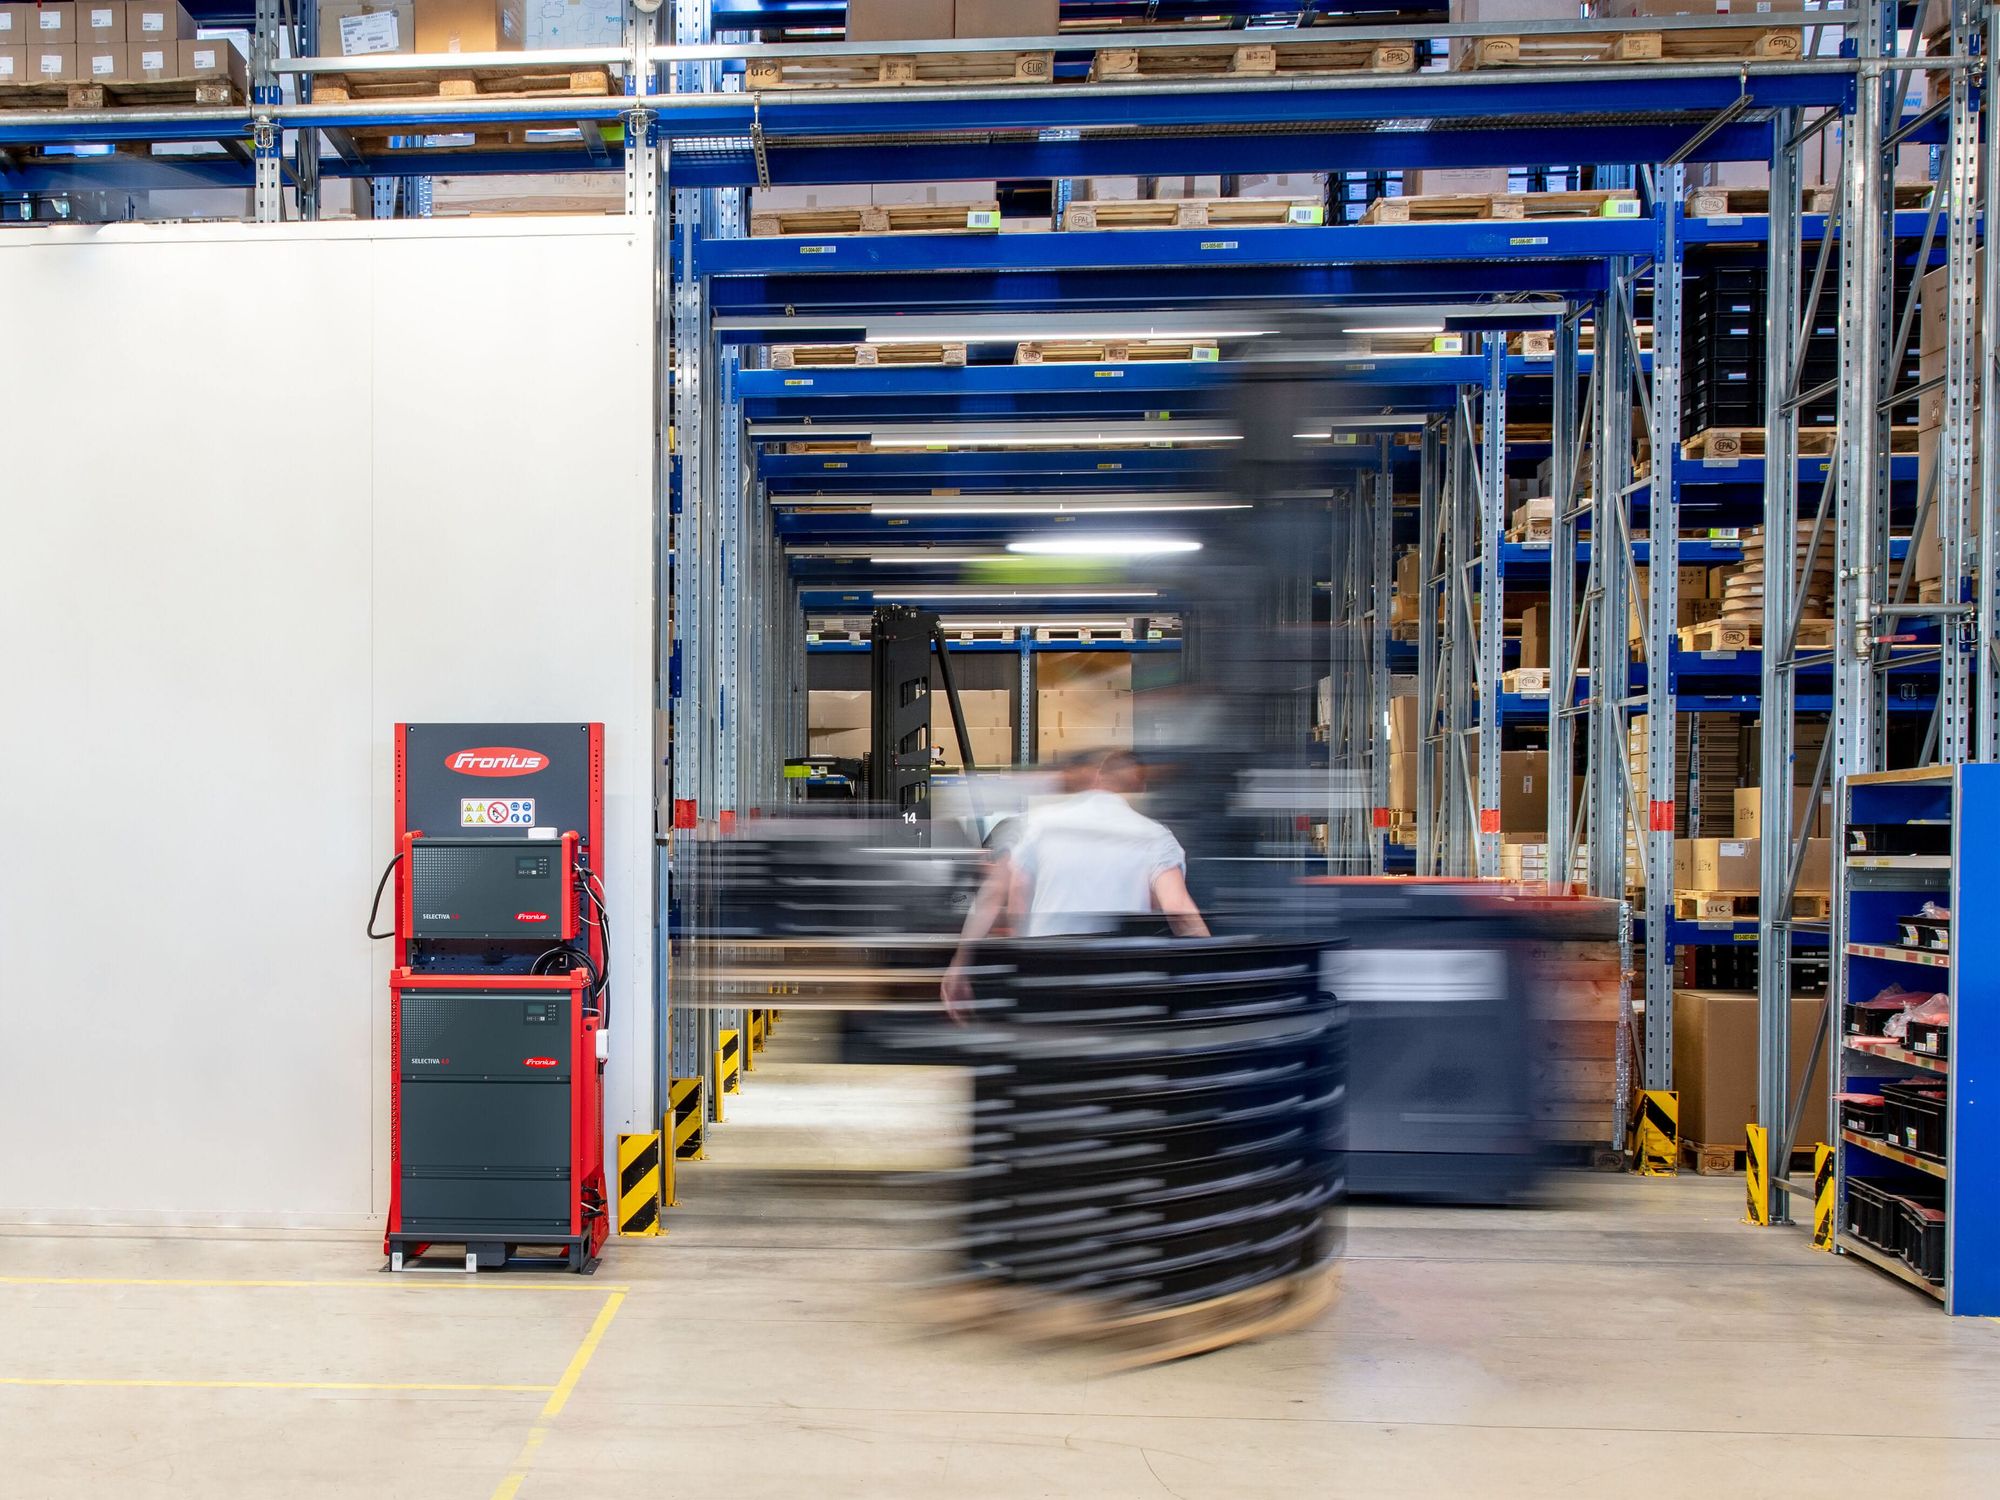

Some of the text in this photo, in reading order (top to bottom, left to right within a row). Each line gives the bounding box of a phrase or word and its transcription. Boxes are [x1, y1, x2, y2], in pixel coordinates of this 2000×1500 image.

[1028, 63, 1042, 73] EUR
[1718, 442, 1733, 450] EPAL
[453, 753, 541, 770] Fronius
[902, 812, 917, 824] 14
[422, 913, 450, 921] SELECTIVA
[525, 1058, 556, 1067] Fronius
